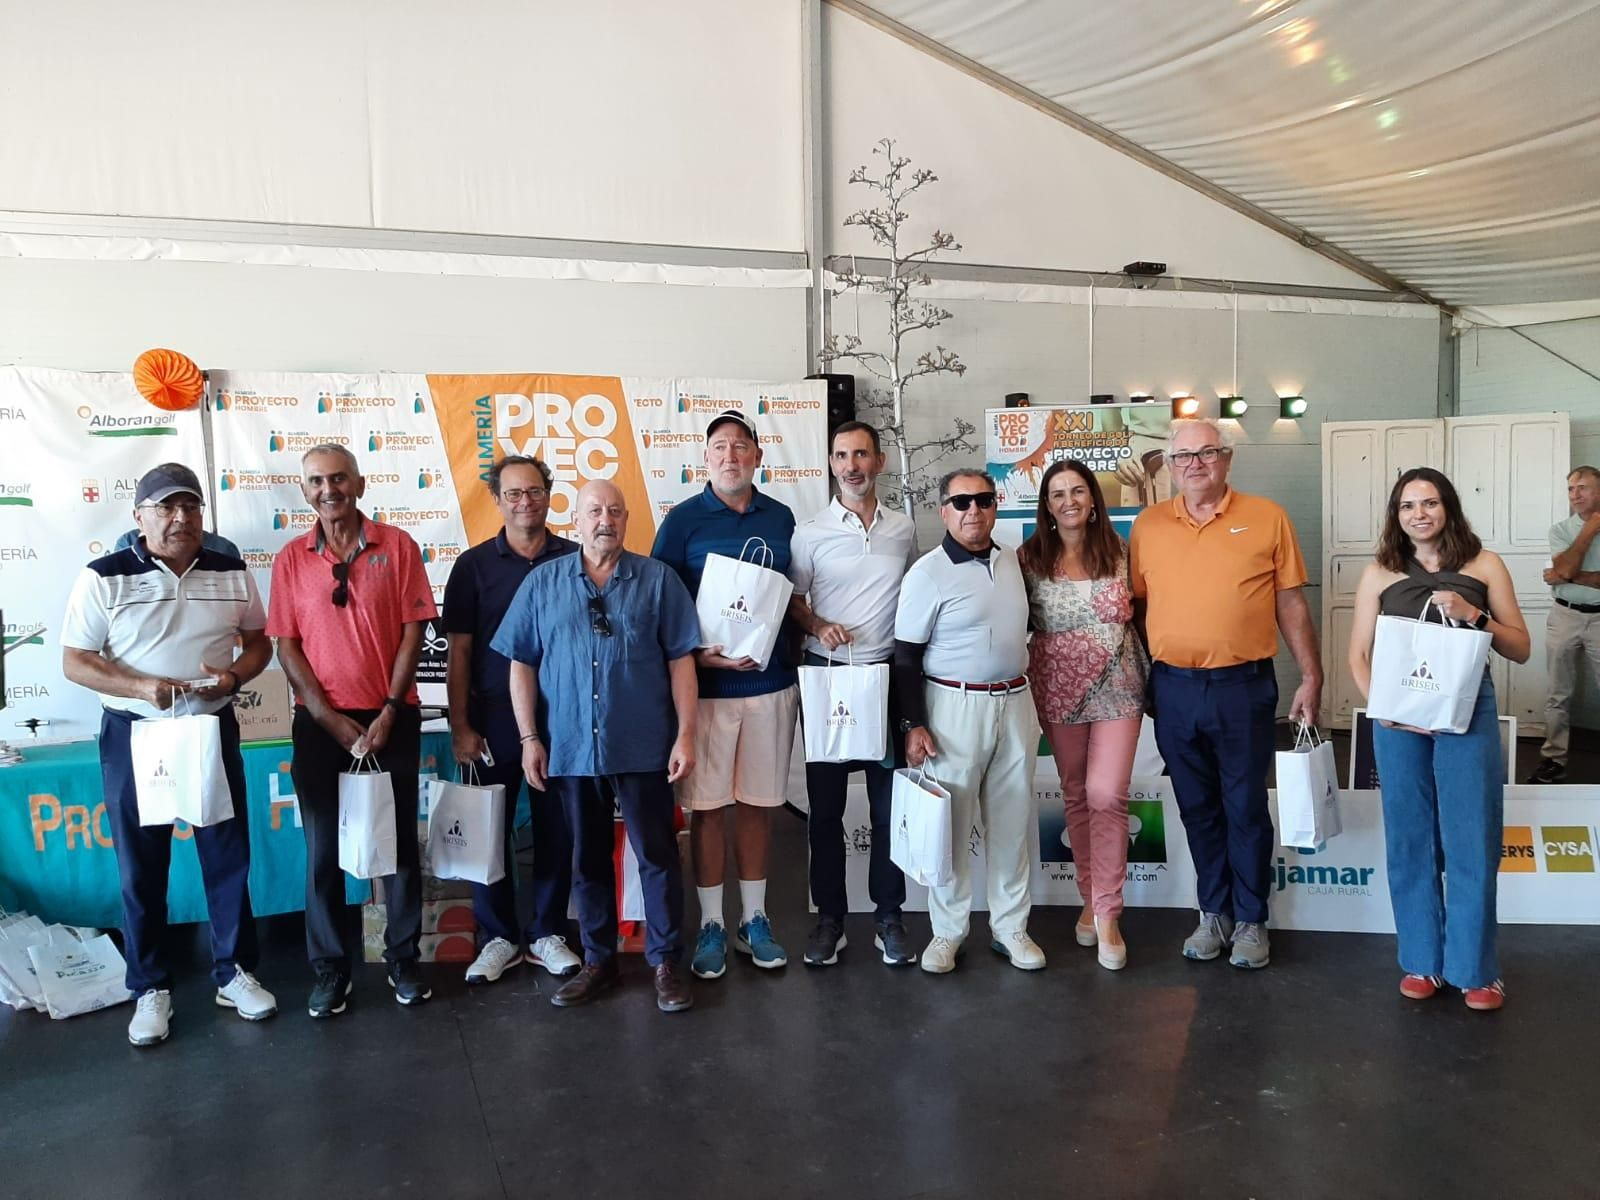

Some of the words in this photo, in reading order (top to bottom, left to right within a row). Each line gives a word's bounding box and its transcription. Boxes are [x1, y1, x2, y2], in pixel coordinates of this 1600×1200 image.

[235, 395, 298, 407] PROYECTO
[336, 397, 396, 407] PROYECTO
[634, 398, 663, 407] ECTO
[693, 399, 743, 408] PROYECTO
[772, 401, 821, 409] PROYECTO
[494, 393, 618, 438] PRO
[999, 413, 1029, 425] PRO
[1053, 411, 1094, 431] XXI
[999, 424, 1029, 435] YEC
[471, 395, 493, 484] ALMERÍA
[654, 433, 705, 443] PROYECTO
[759, 435, 784, 444] ECTO
[999, 435, 1019, 446] TO
[1053, 432, 1092, 440] TORNEO
[1094, 431, 1108, 439] DE
[1110, 431, 1136, 439] GOLF
[288, 436, 350, 446] PROYECTO
[1061, 439, 1112, 448] BENEFICIO
[1114, 438, 1129, 447] DE
[1053, 447, 1132, 460] PROYECTO
[775, 469, 823, 478] PROYECTO
[240, 474, 302, 484] PROYECTO
[390, 510, 449, 520] PROYECTO
[243, 553, 274, 562] PROY
[720, 607, 752, 624] BRISEIS
[1401, 677, 1441, 692] BRISEIS
[826, 717, 858, 727] BRISEIS
[1501, 844, 1535, 858] ERYS
[1544, 841, 1593, 856] CYSA
[1270, 857, 1375, 892] jamar
[1308, 886, 1334, 896] CAJA
[1338, 887, 1373, 897] RURAL
